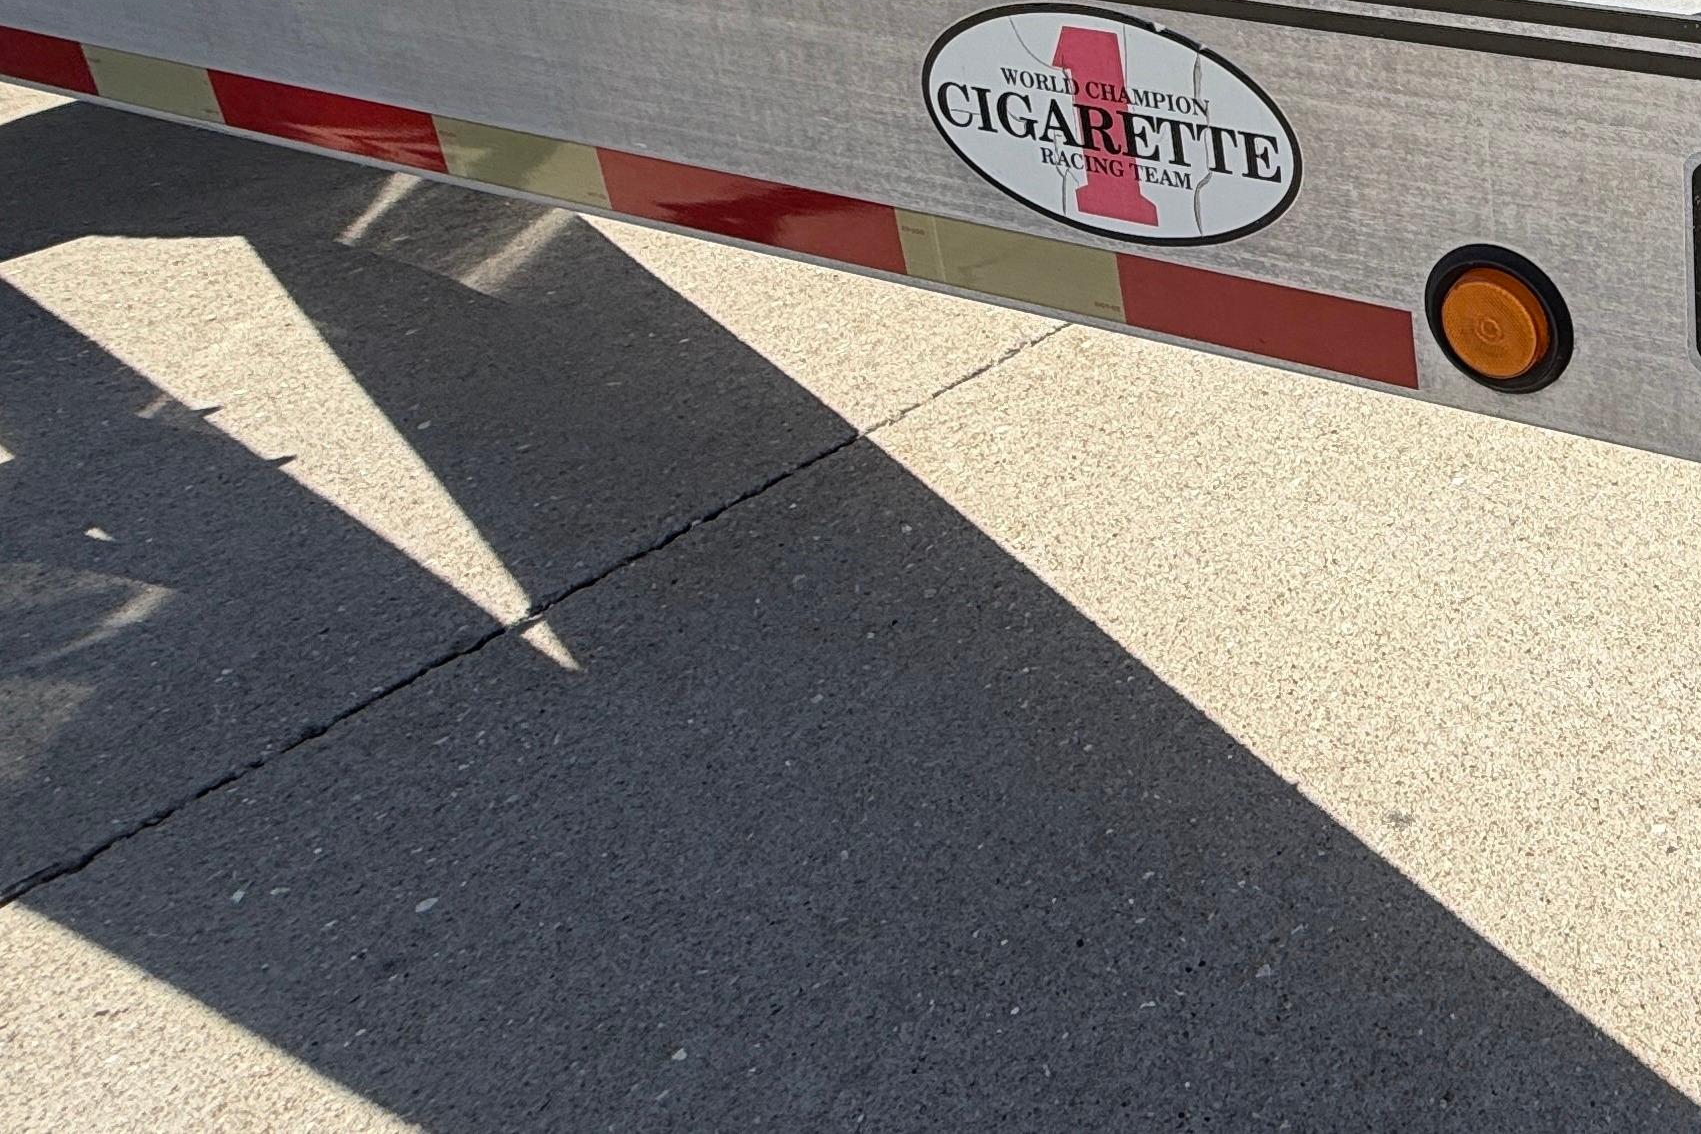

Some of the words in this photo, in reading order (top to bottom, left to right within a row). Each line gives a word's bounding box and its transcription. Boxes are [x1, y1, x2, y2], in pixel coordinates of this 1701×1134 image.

[1000, 67, 1078, 96] WORLD
[1085, 80, 1210, 116] CHAMPION
[937, 81, 1283, 183] CIGARETTE
[1041, 147, 1125, 178] RACING
[1129, 163, 1193, 190] TEAM
